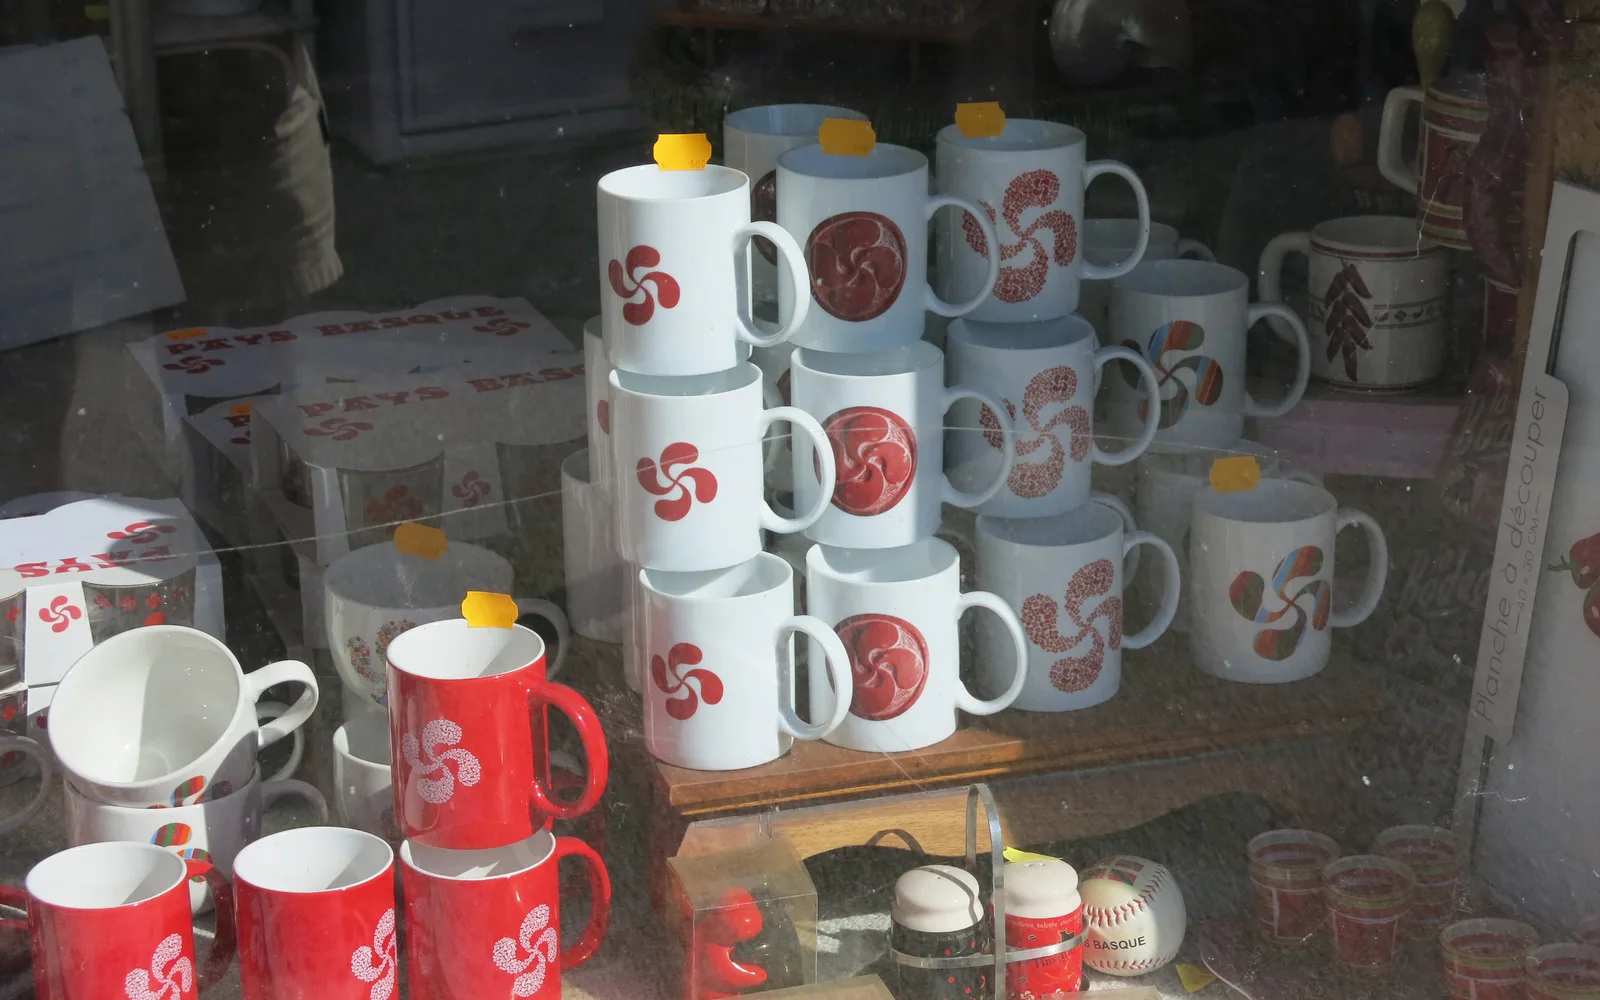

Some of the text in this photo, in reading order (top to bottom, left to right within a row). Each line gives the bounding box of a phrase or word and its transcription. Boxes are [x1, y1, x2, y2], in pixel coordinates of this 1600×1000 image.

[165, 306, 506, 355] PAYS BASQUE
[297, 386, 449, 417] PAYS
[14, 546, 172, 578] PAYS
[1475, 386, 1546, 721] Planche à découper
[1523, 550, 1534, 571] 30
[1093, 936, 1147, 950] BASQUE
